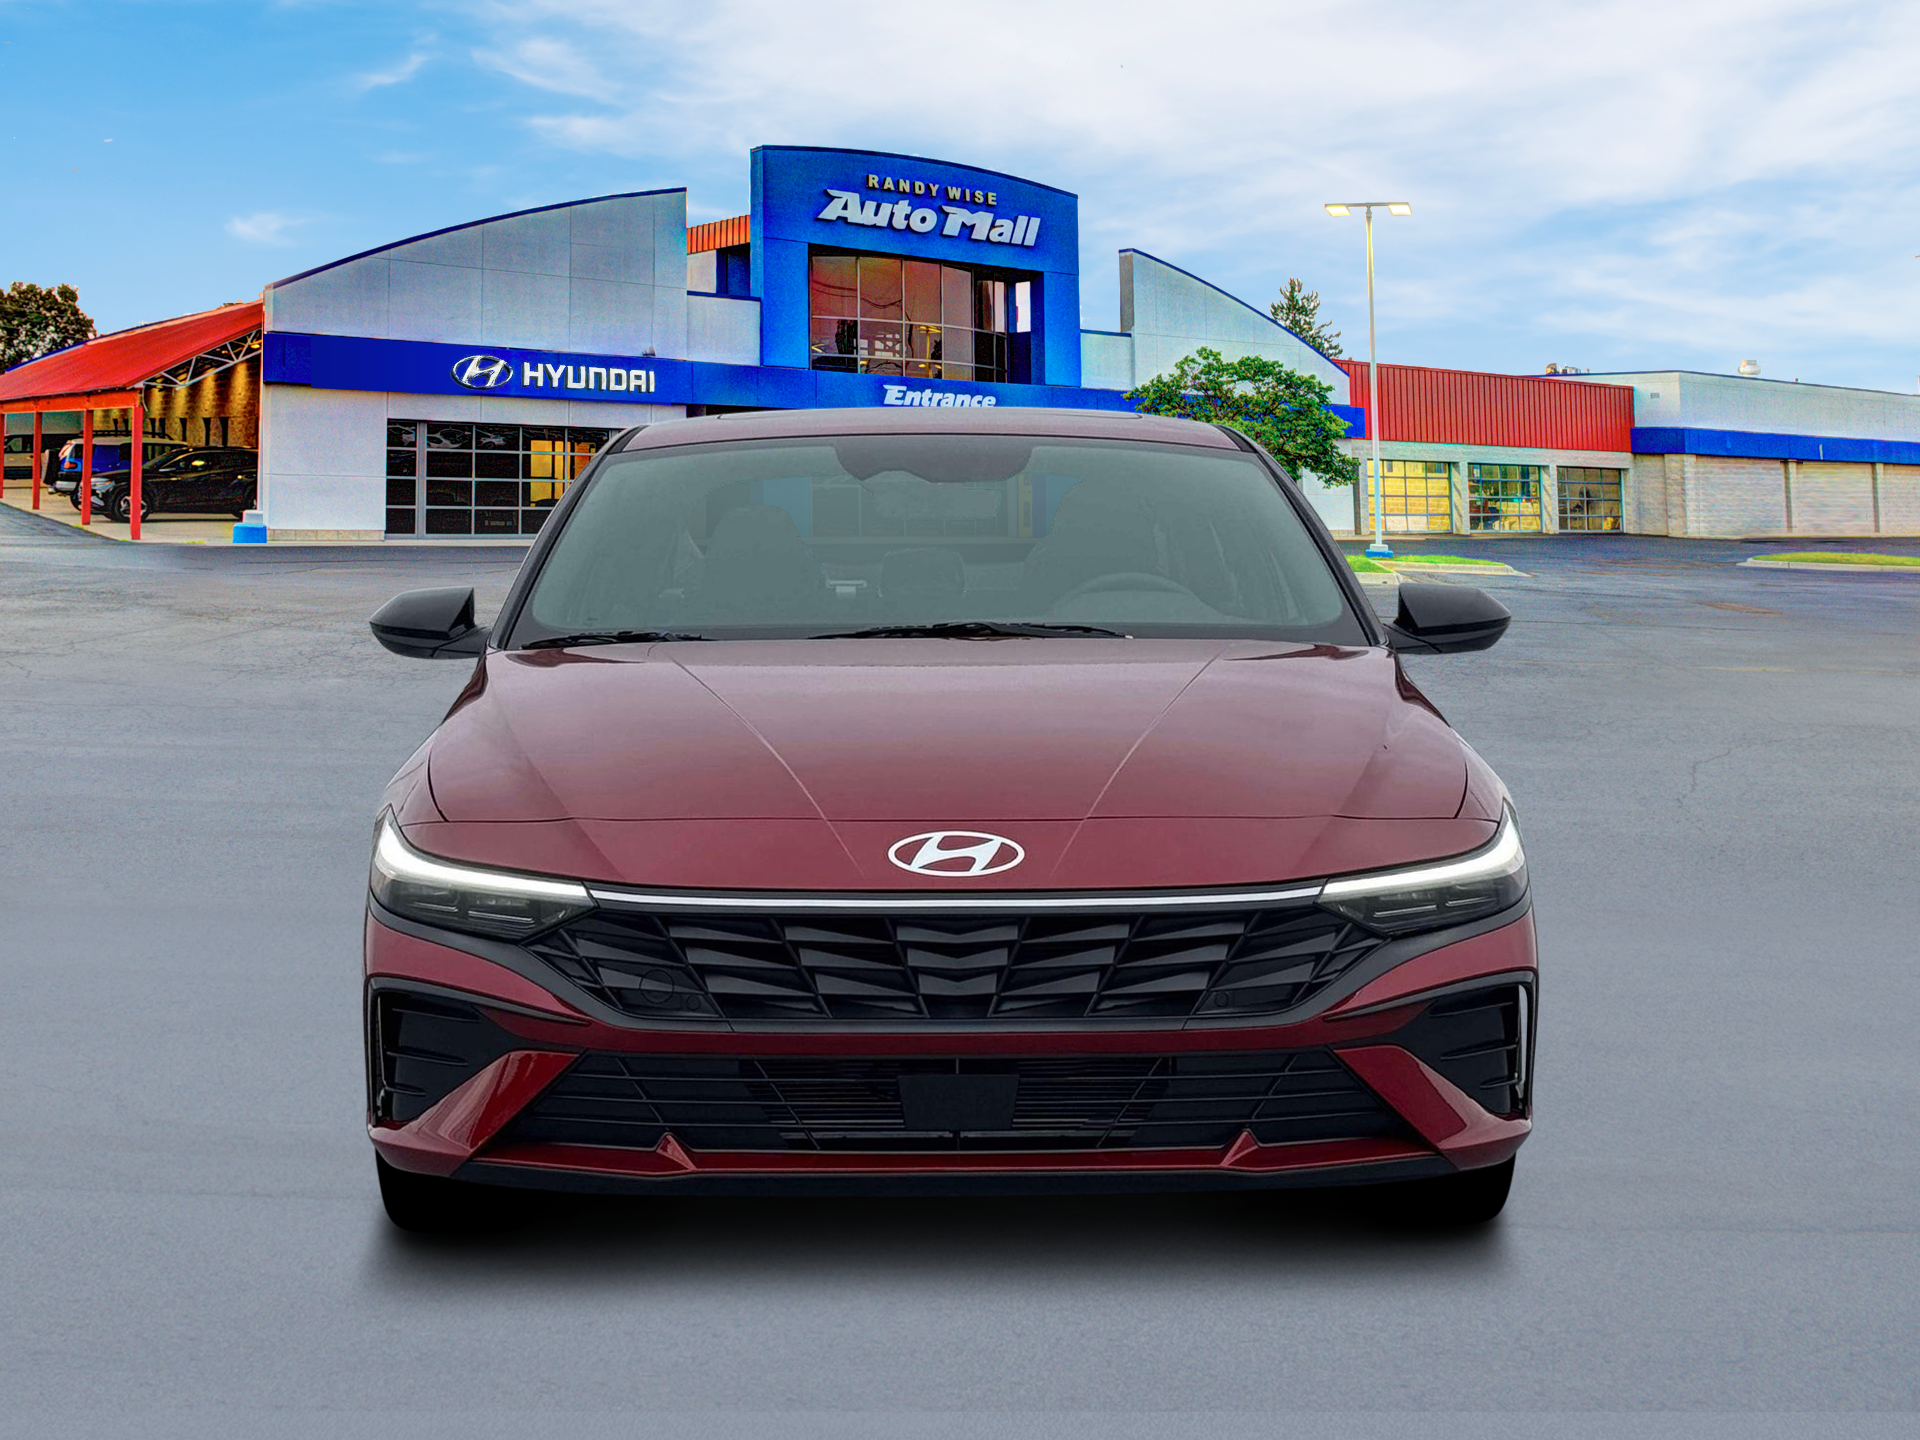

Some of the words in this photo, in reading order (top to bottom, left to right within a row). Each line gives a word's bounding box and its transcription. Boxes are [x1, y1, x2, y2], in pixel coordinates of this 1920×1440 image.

[867, 174, 939, 197] RANDY
[947, 185, 997, 206] WISE
[816, 188, 938, 233] Auto
[941, 204, 1041, 247] Mall
[522, 361, 655, 392] HYUNDAI
[882, 384, 997, 407] Entrance
